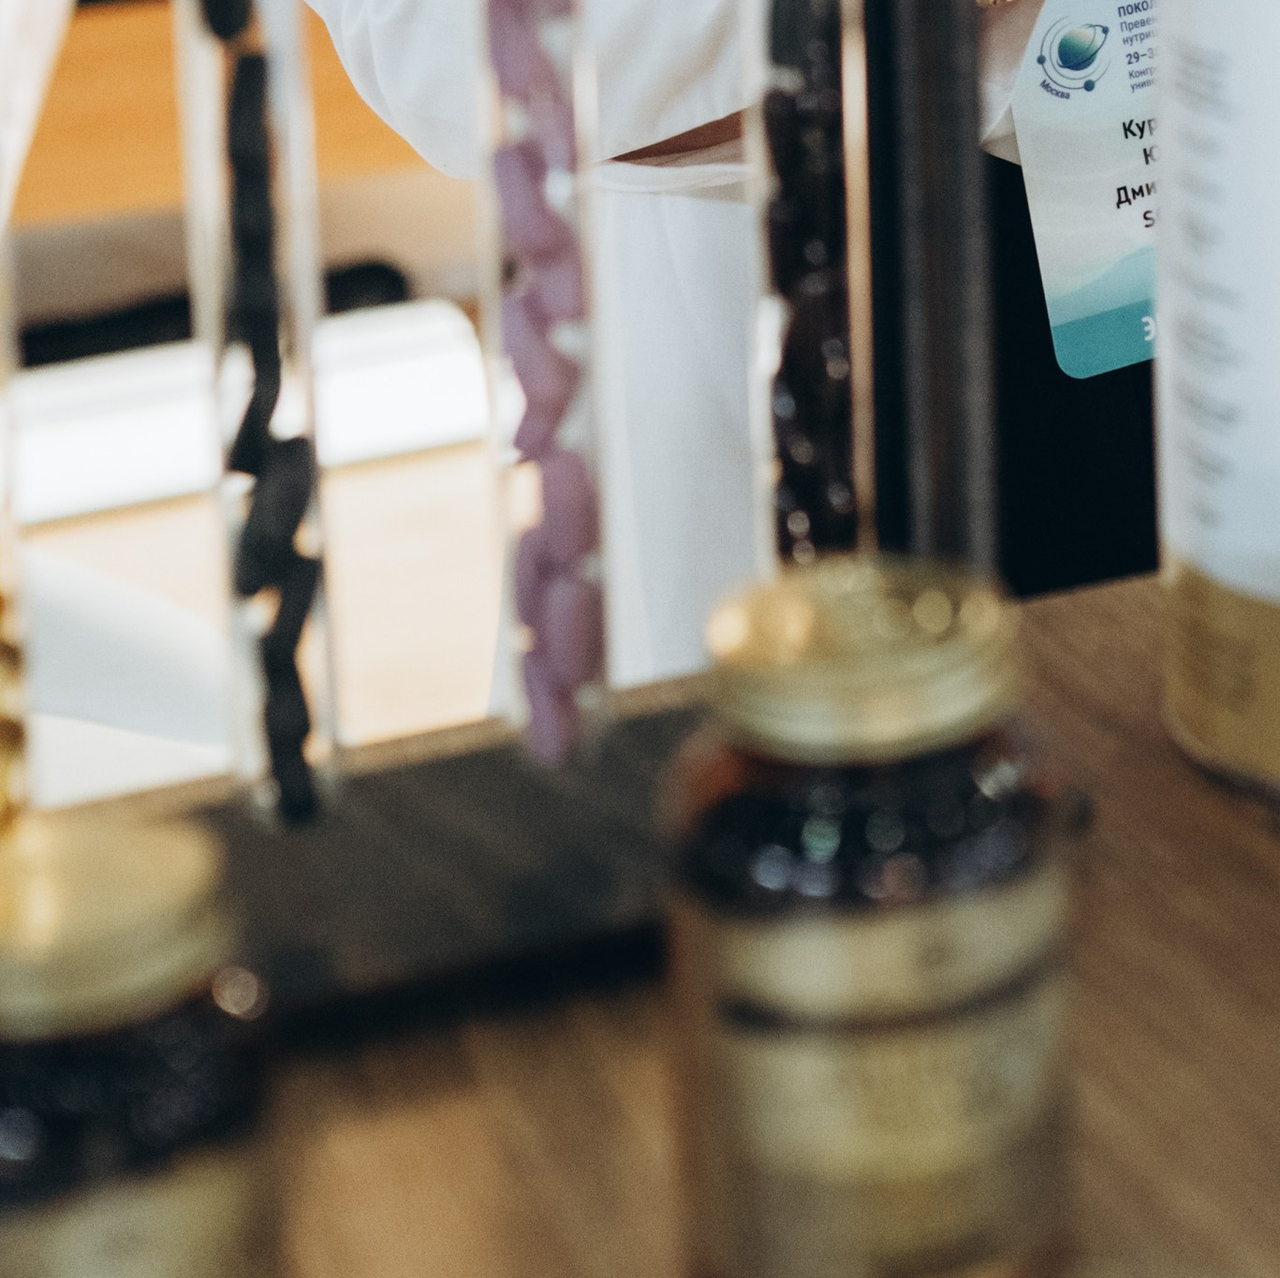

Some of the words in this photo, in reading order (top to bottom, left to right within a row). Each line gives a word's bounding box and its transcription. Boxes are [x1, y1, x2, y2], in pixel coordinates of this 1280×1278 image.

[1040, 79, 1070, 99] Москва
[1122, 118, 1157, 139] Кур
[1143, 145, 1160, 165] Ю
[1116, 182, 1158, 209] Дми
[1143, 209, 1159, 228] S
[1141, 315, 1156, 341] Э
